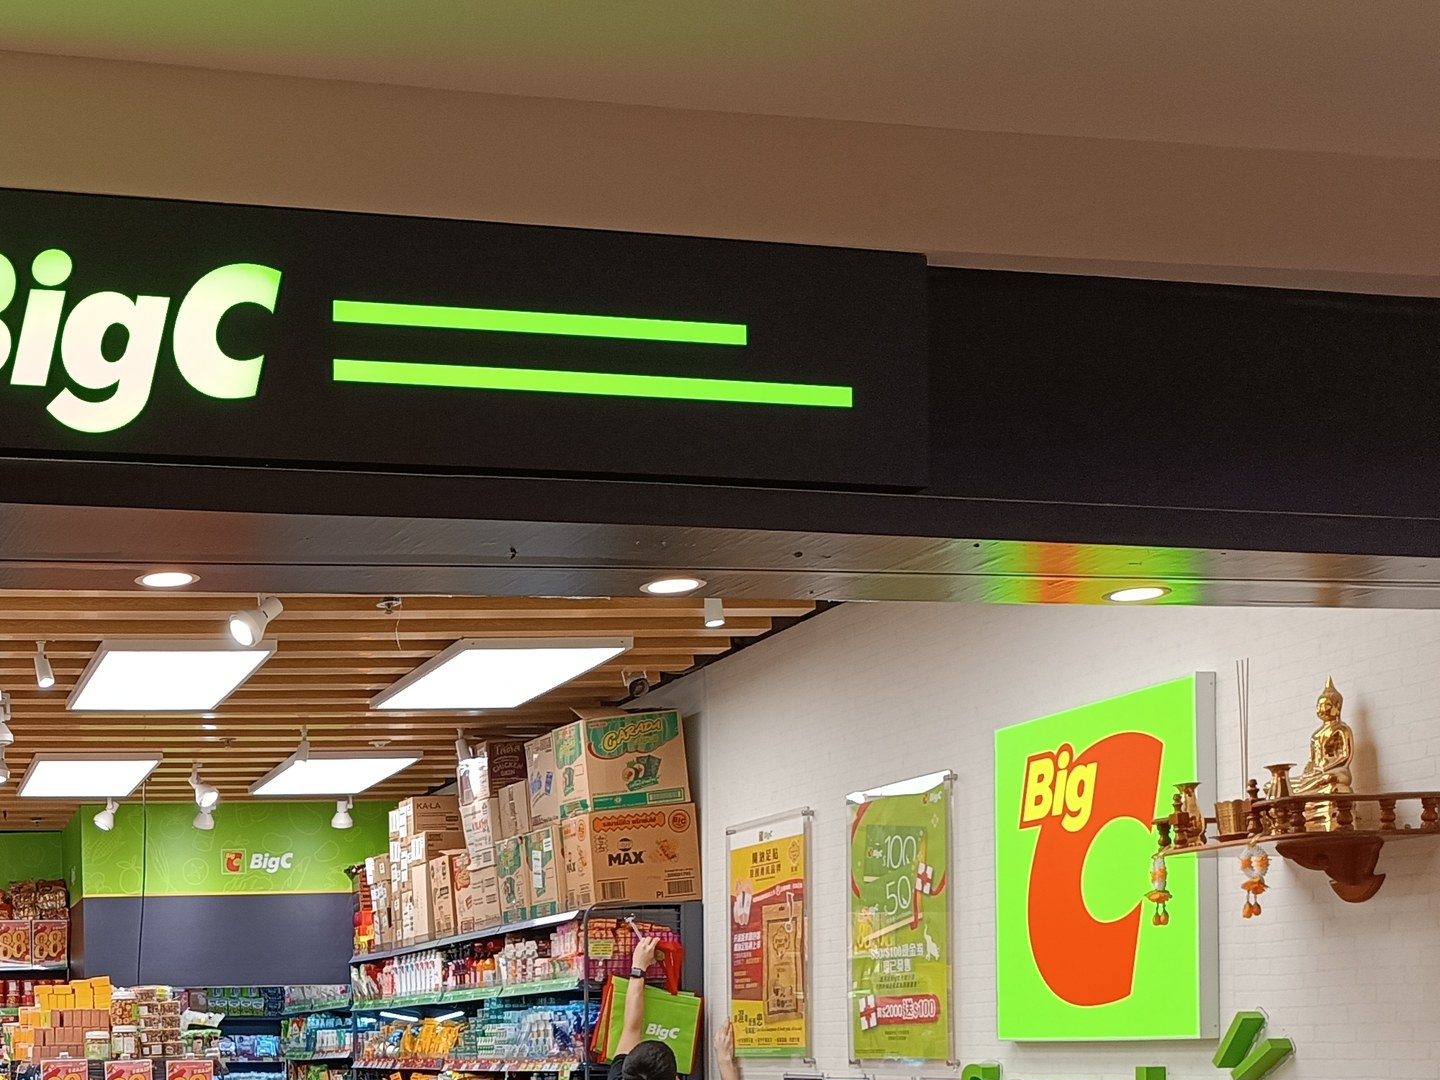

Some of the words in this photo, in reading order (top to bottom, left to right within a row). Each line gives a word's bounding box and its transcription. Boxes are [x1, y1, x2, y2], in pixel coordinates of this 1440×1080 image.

[1021, 744, 1097, 833] Big
[249, 852, 293, 873] BigC
[609, 851, 644, 866] MAX
[35, 932, 62, 960] 88
[646, 1023, 679, 1040] BigC
